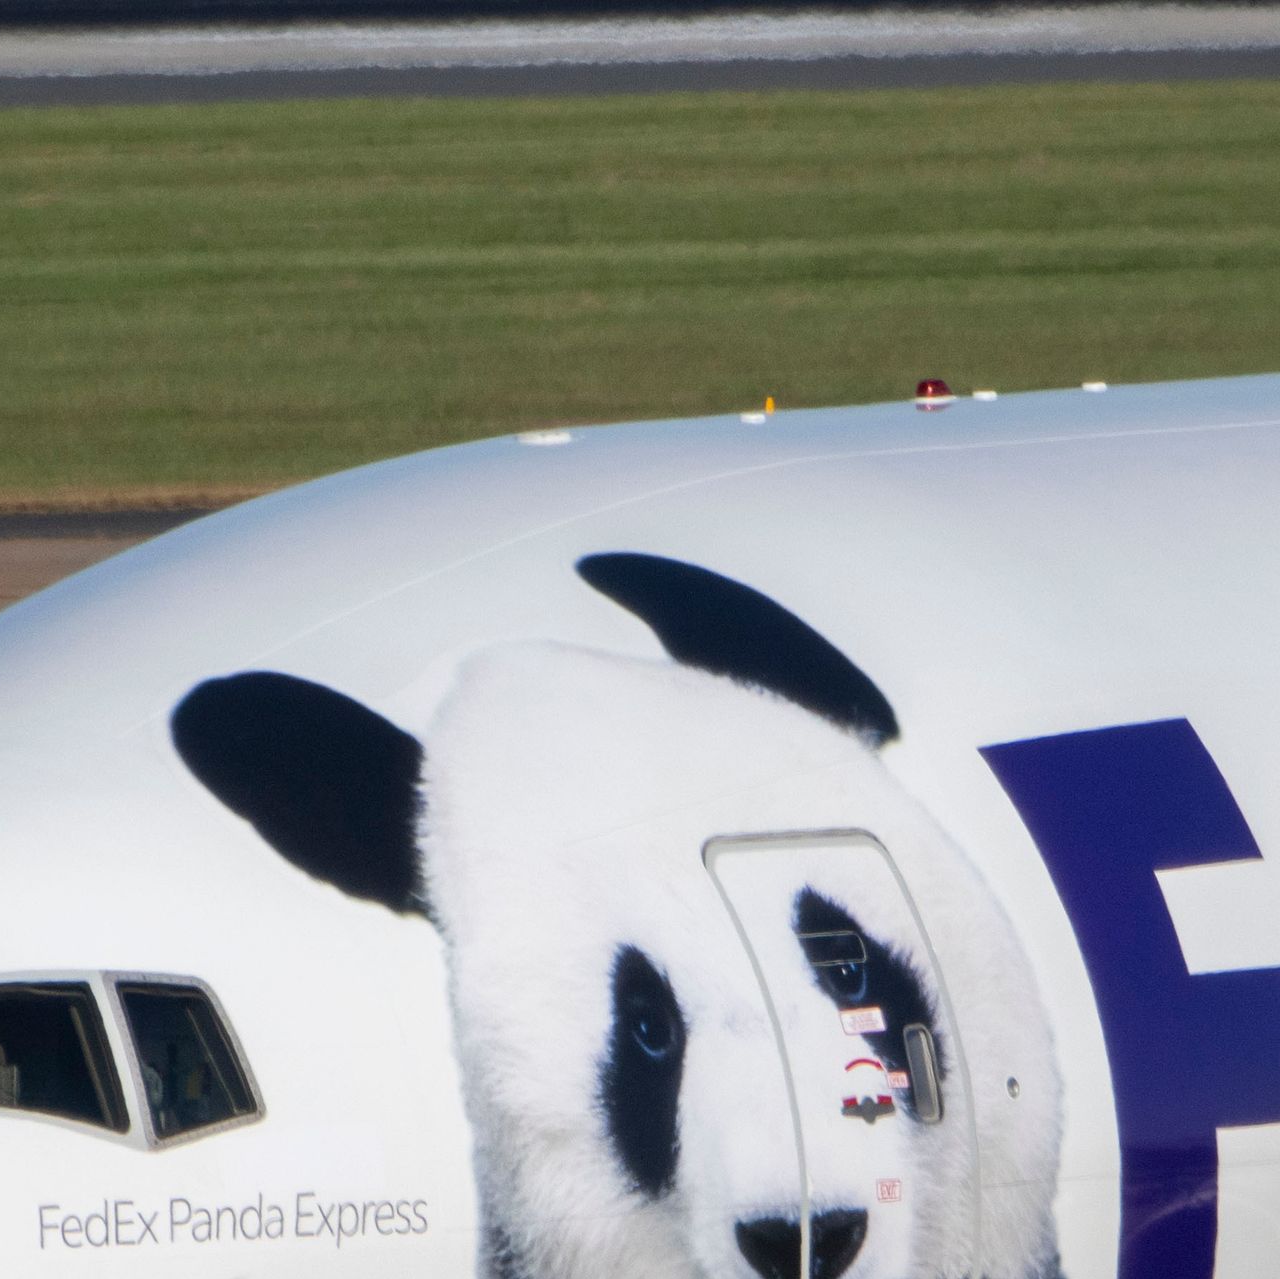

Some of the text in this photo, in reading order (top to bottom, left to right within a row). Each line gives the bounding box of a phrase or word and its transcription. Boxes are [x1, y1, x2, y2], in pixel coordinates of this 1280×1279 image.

[38, 1192, 429, 1249] FedEx Panda Express
